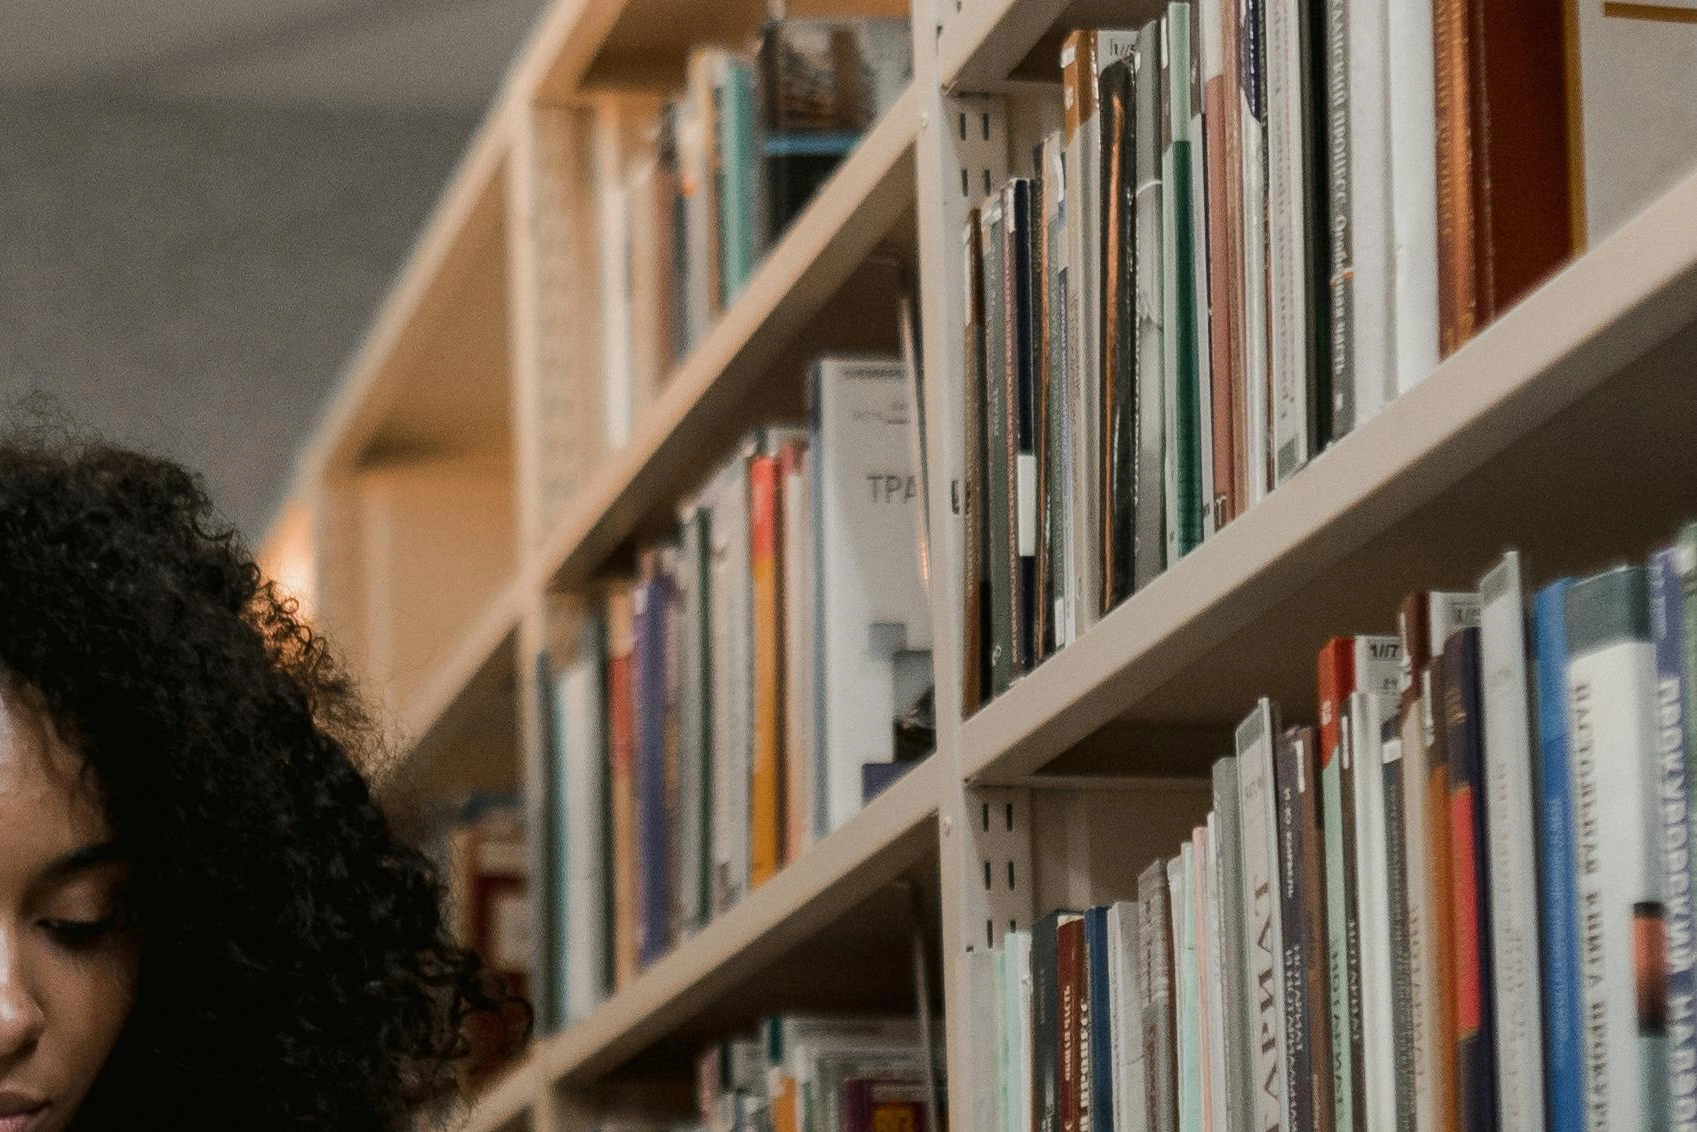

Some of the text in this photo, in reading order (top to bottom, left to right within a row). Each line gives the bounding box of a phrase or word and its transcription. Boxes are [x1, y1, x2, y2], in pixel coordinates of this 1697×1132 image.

[1333, 110, 1346, 206] ПРОЦЕСС
[1575, 680, 1598, 876] НАСТОЛЬНАЯ
[1660, 677, 1695, 974] ПРОКУРОРСКИЙ
[1586, 889, 1605, 986] КНИГА
[1079, 996, 1090, 1110] ПРОЦЕСС
